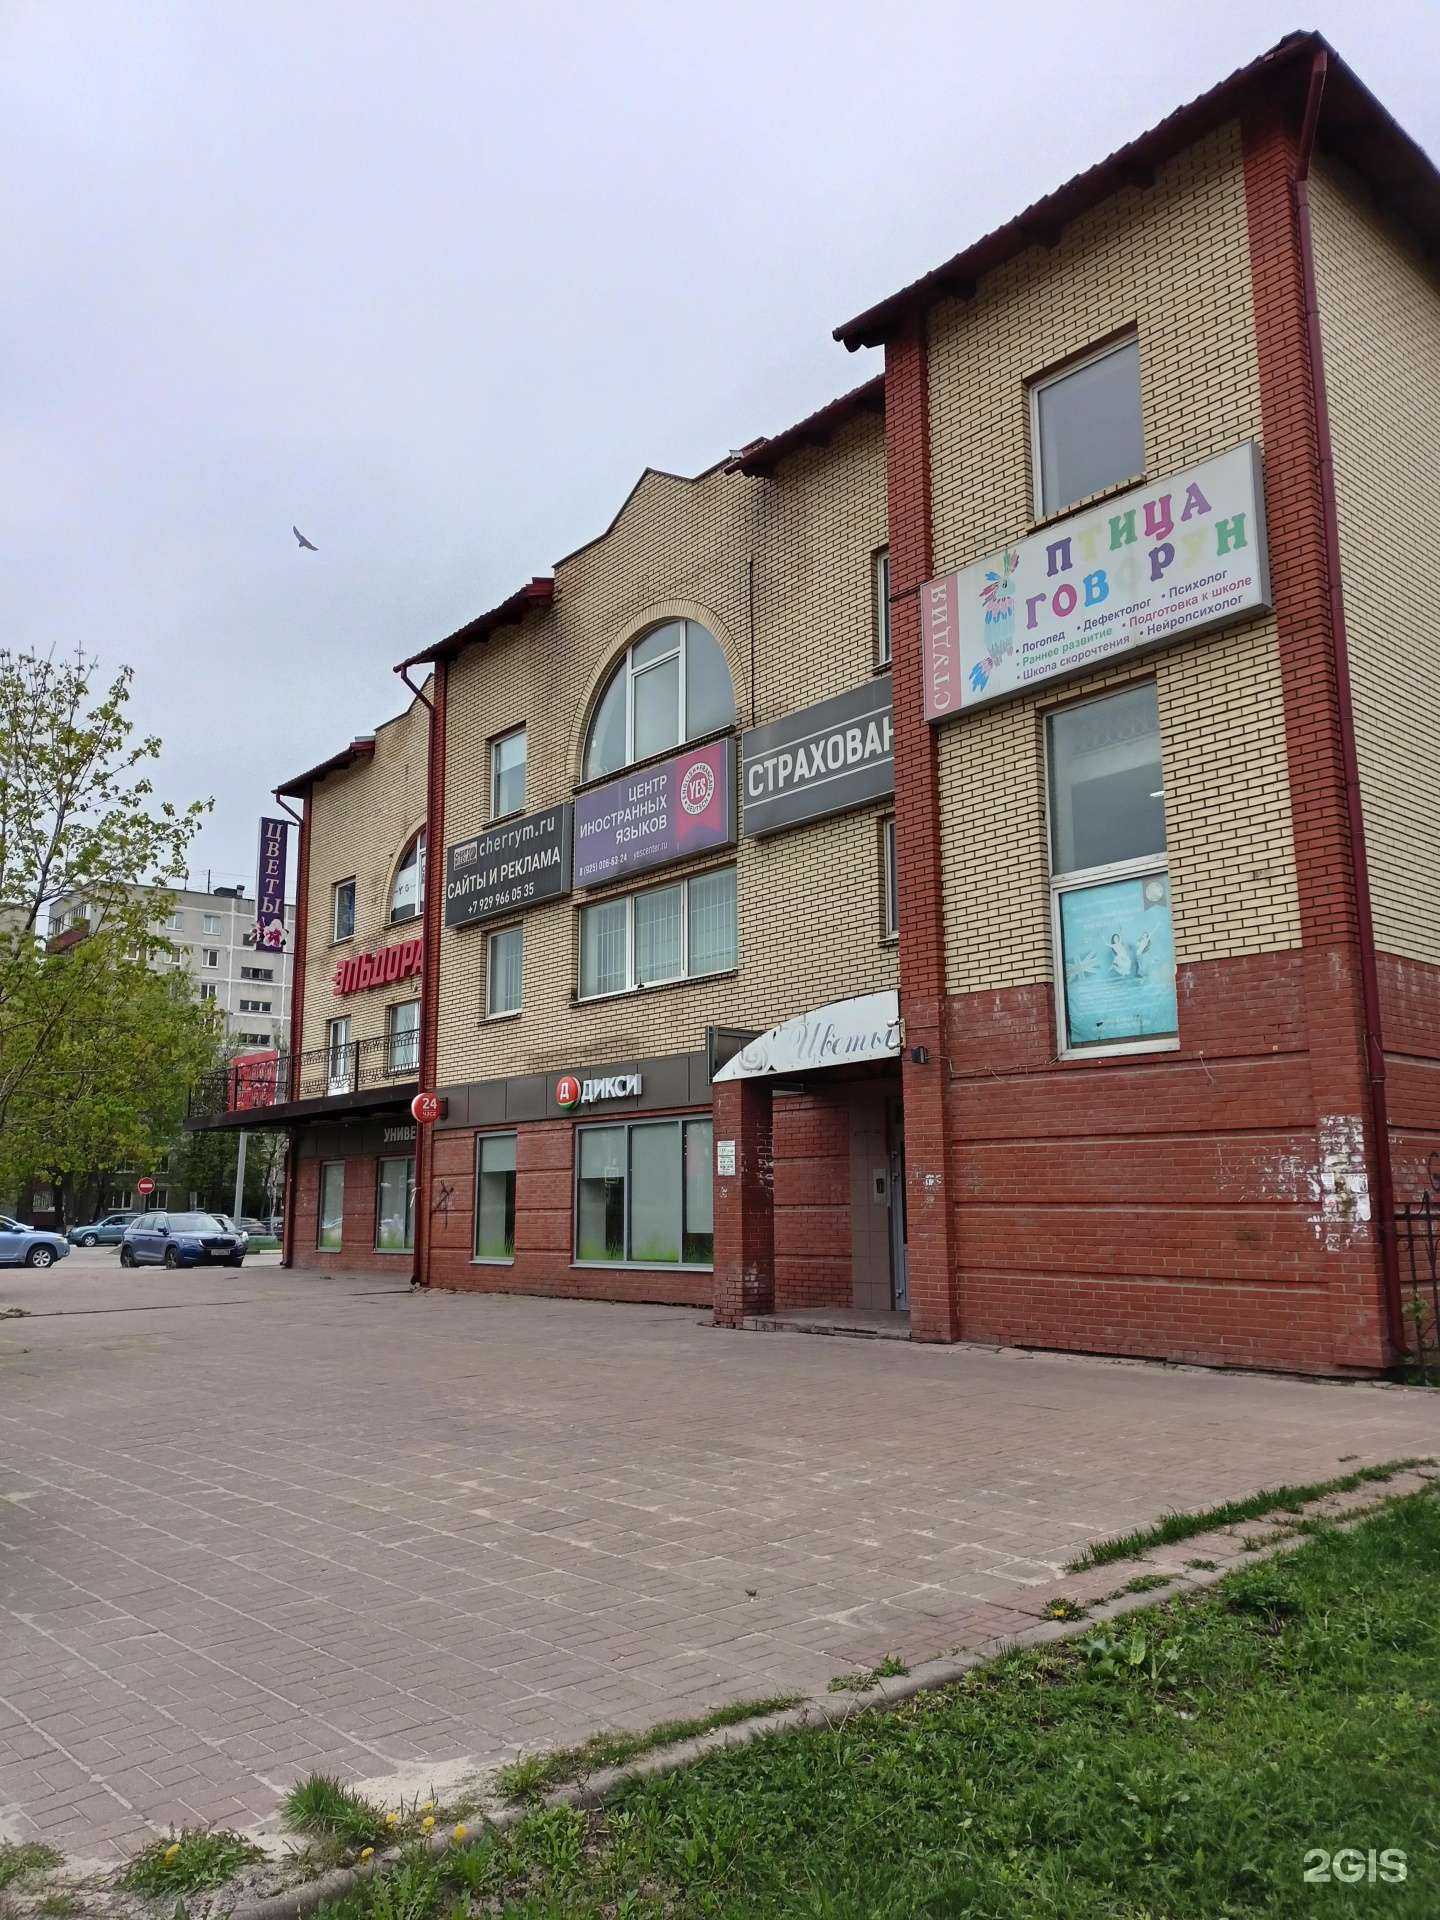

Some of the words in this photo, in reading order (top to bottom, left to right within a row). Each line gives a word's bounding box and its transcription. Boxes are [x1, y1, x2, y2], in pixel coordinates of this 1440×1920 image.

[1046, 482, 1213, 577] ПТИЦА
[1022, 631, 1065, 654] Логопед
[1084, 598, 1151, 632] Дефектолог
[1169, 568, 1228, 598] Психолог
[1022, 647, 1059, 667] Раннее
[1062, 627, 1112, 655] развитие
[1129, 596, 1199, 627] Подготовка
[1202, 592, 1209, 601] к
[1212, 576, 1252, 598] школе
[931, 583, 951, 710] СТУДИЯ
[1023, 662, 1057, 680] Школа
[1060, 636, 1130, 667] скорочтения
[1147, 594, 1244, 636] Нейропсихолог
[628, 775, 667, 802] ЦЕНТР
[690, 777, 706, 800] YES
[480, 816, 555, 856] cherrym.ru
[580, 794, 667, 839] ИНОСТРАННЫХ
[615, 815, 667, 845] ЯЗЫКОВ
[260, 822, 282, 914] ЦВЕТЫ
[448, 871, 486, 900] САЙТЫ
[489, 867, 498, 886] И
[500, 846, 560, 882] РЕКЛАМА
[468, 901, 478, 914] +7
[479, 896, 493, 911] 929
[495, 891, 509, 905] 966
[512, 886, 522, 900] 05
[523, 881, 534, 896] 35
[422, 1098, 437, 1109] 24
[560, 1082, 569, 1099] Д
[581, 1074, 642, 1103] ДИКСИ
